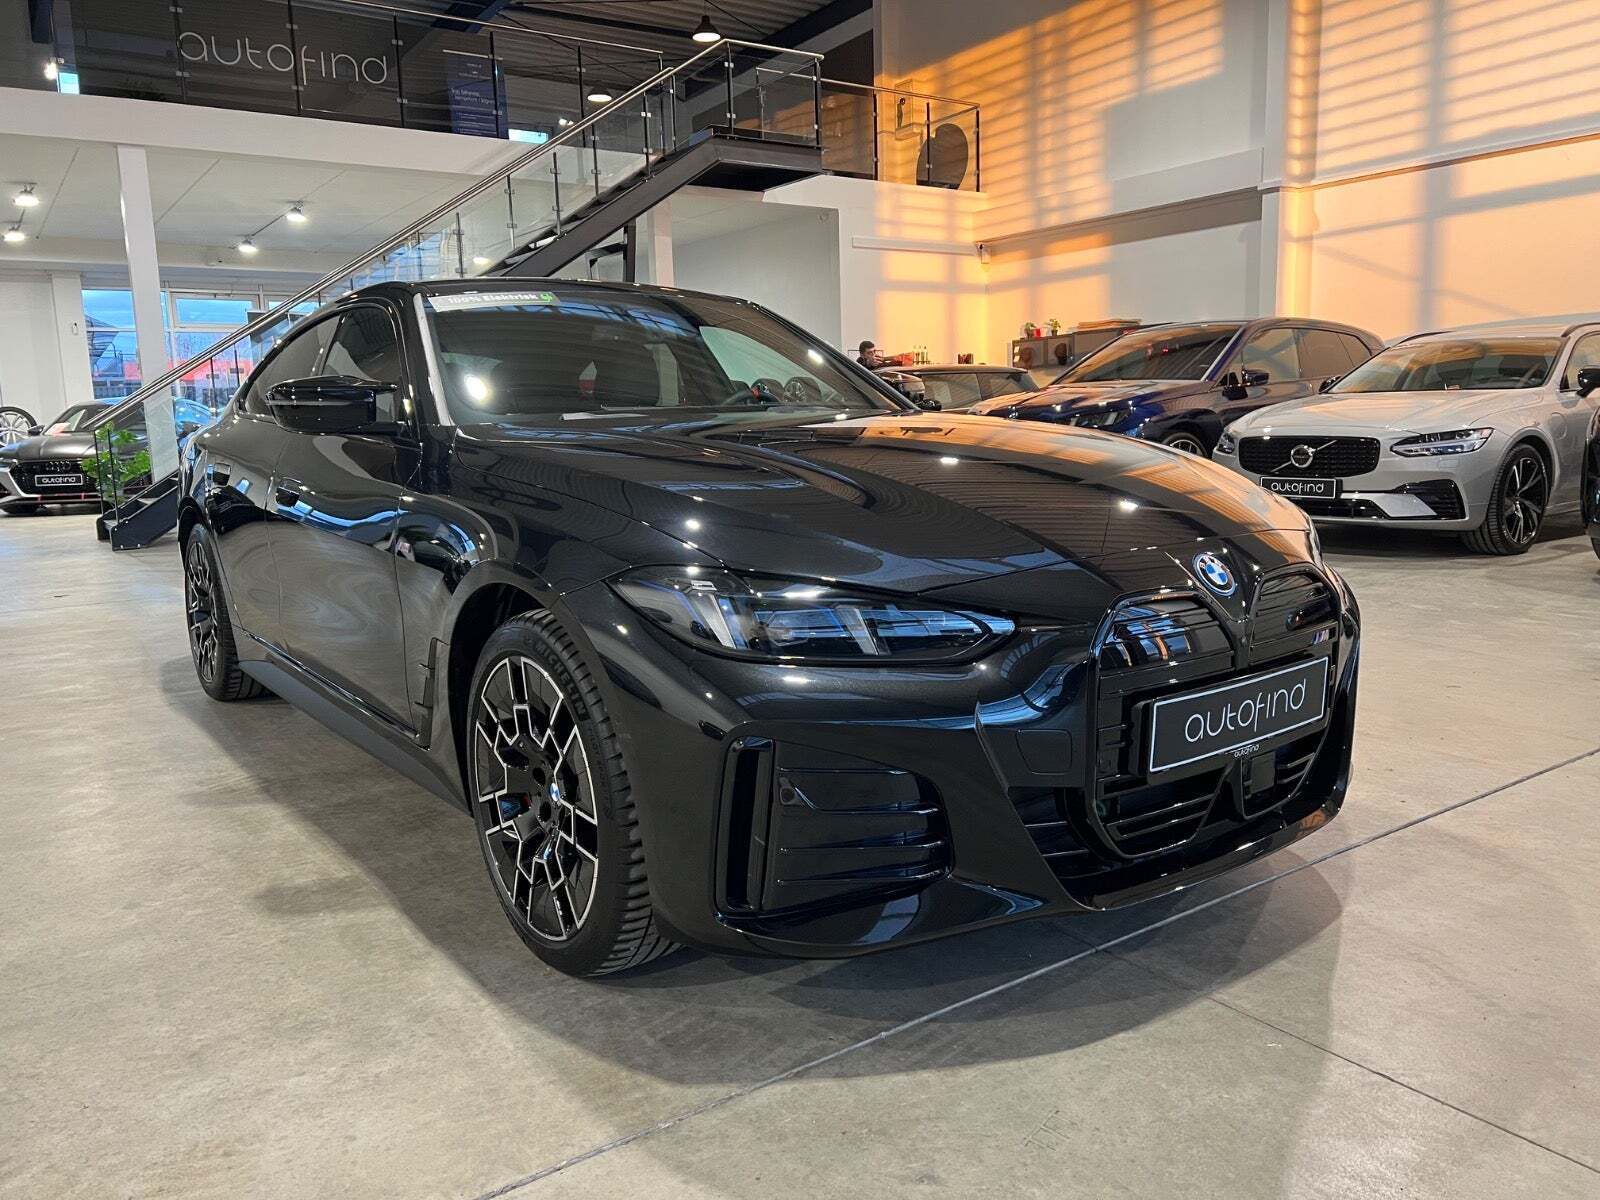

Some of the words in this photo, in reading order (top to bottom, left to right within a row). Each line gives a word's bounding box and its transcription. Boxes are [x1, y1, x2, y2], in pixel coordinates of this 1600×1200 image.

[177, 31, 388, 86] autofind
[1270, 482, 1325, 495] autofind
[534, 638, 587, 717] MICHELIN
[1184, 678, 1307, 743] autofind
